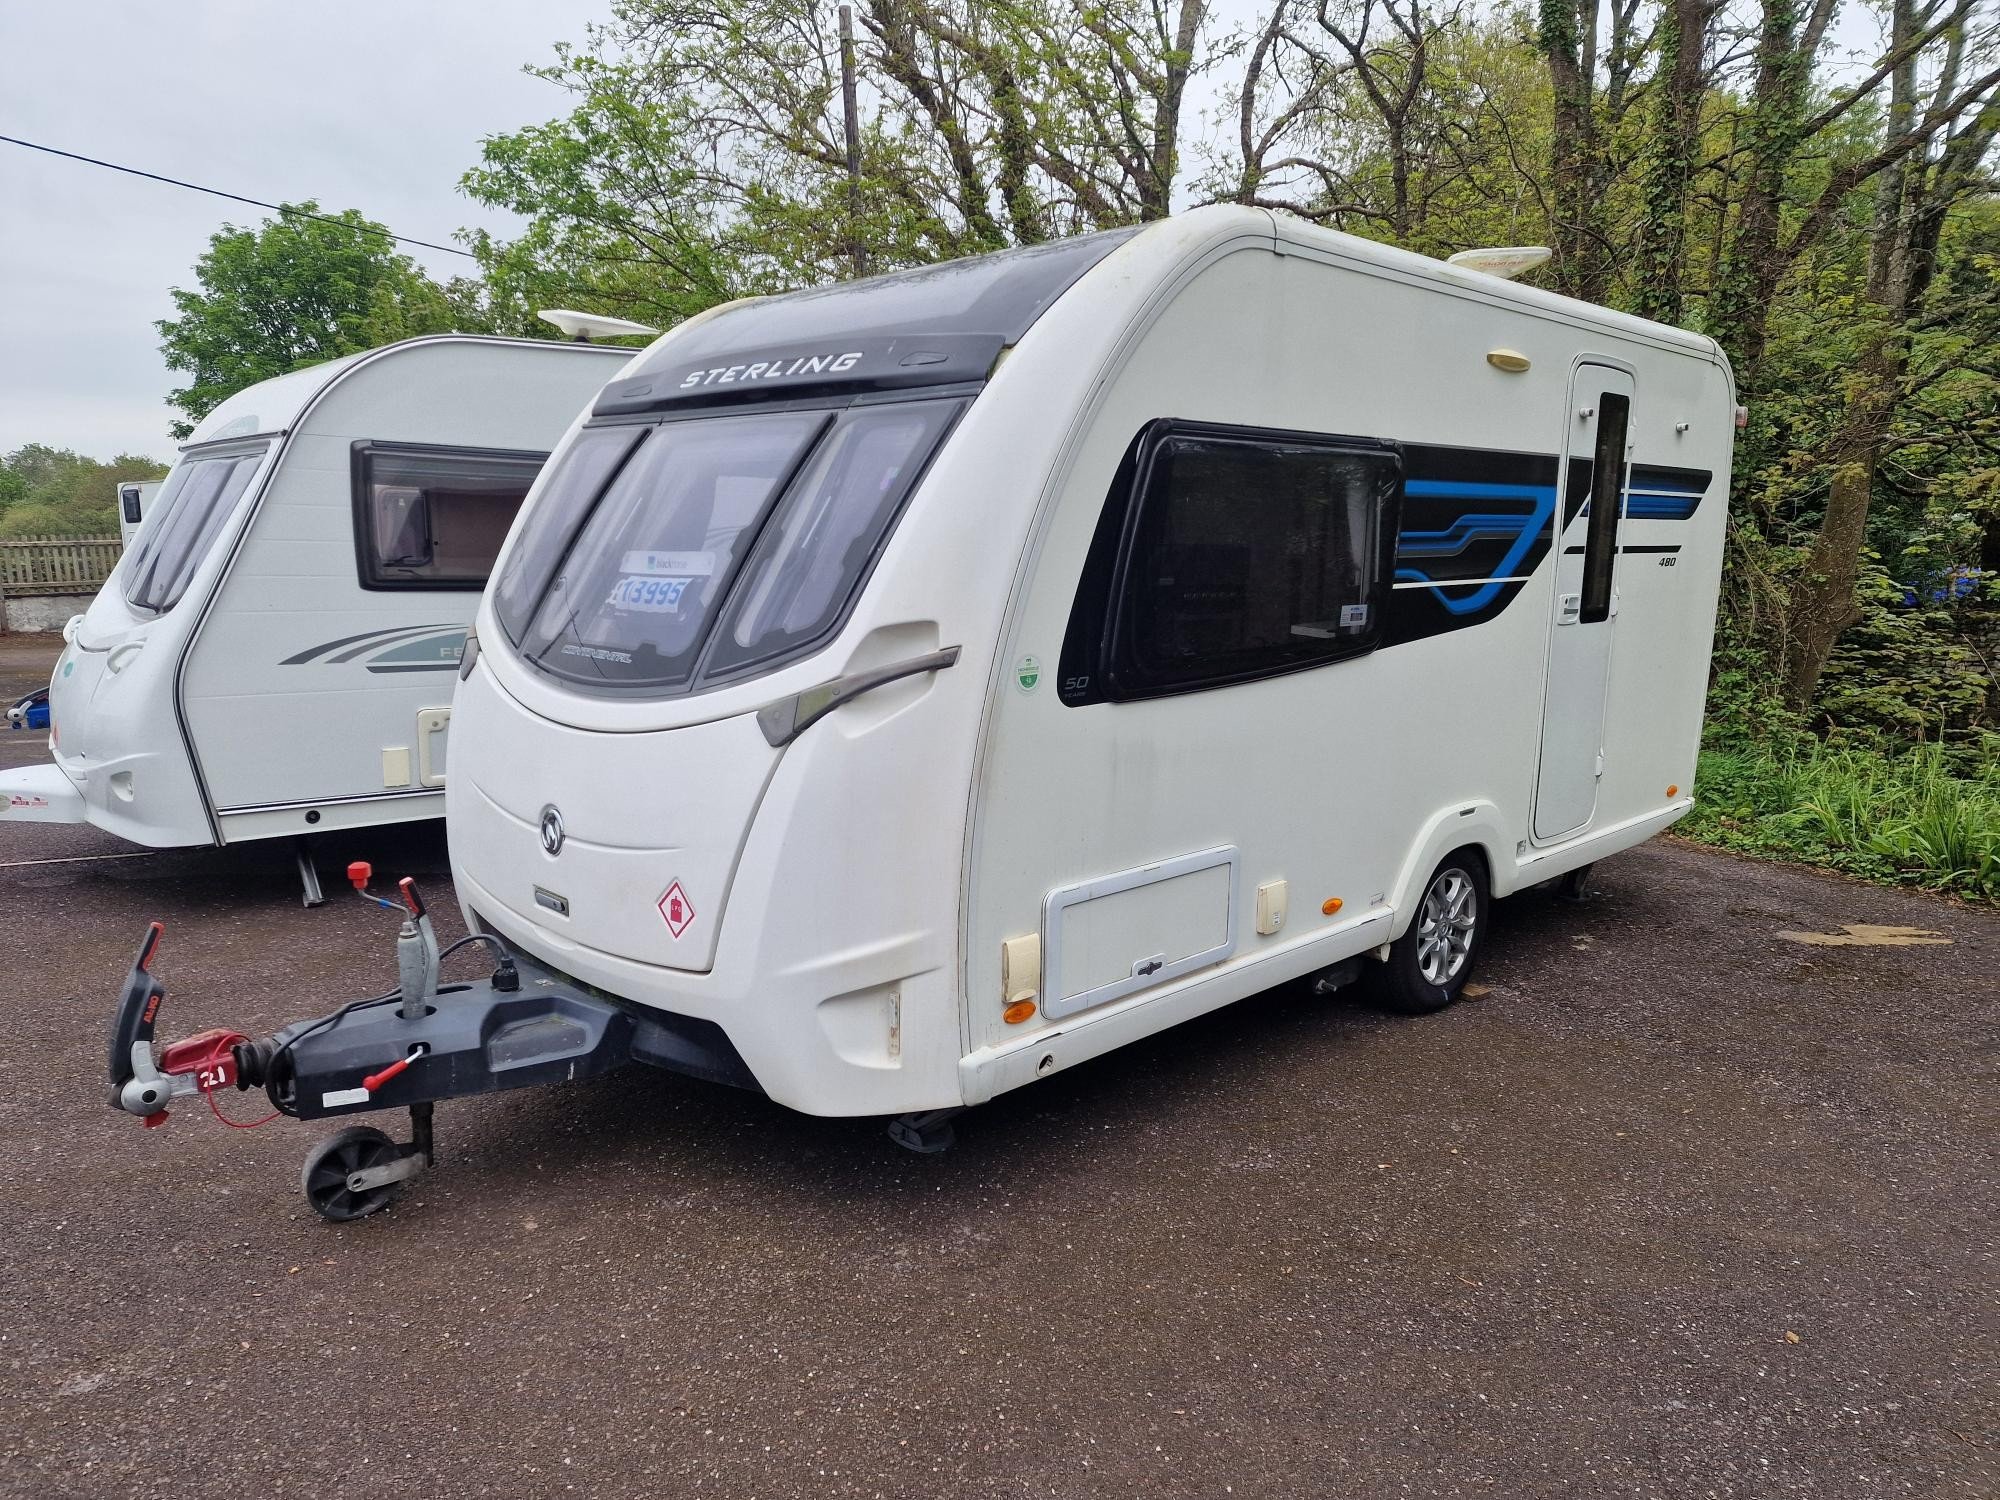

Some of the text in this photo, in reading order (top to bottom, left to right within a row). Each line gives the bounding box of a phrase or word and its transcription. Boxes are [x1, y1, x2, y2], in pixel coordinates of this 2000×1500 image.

[680, 352, 863, 388] STERLING
[1659, 557, 1677, 567] 480
[1065, 676, 1089, 690] 50
[200, 1065, 226, 1088] 21
